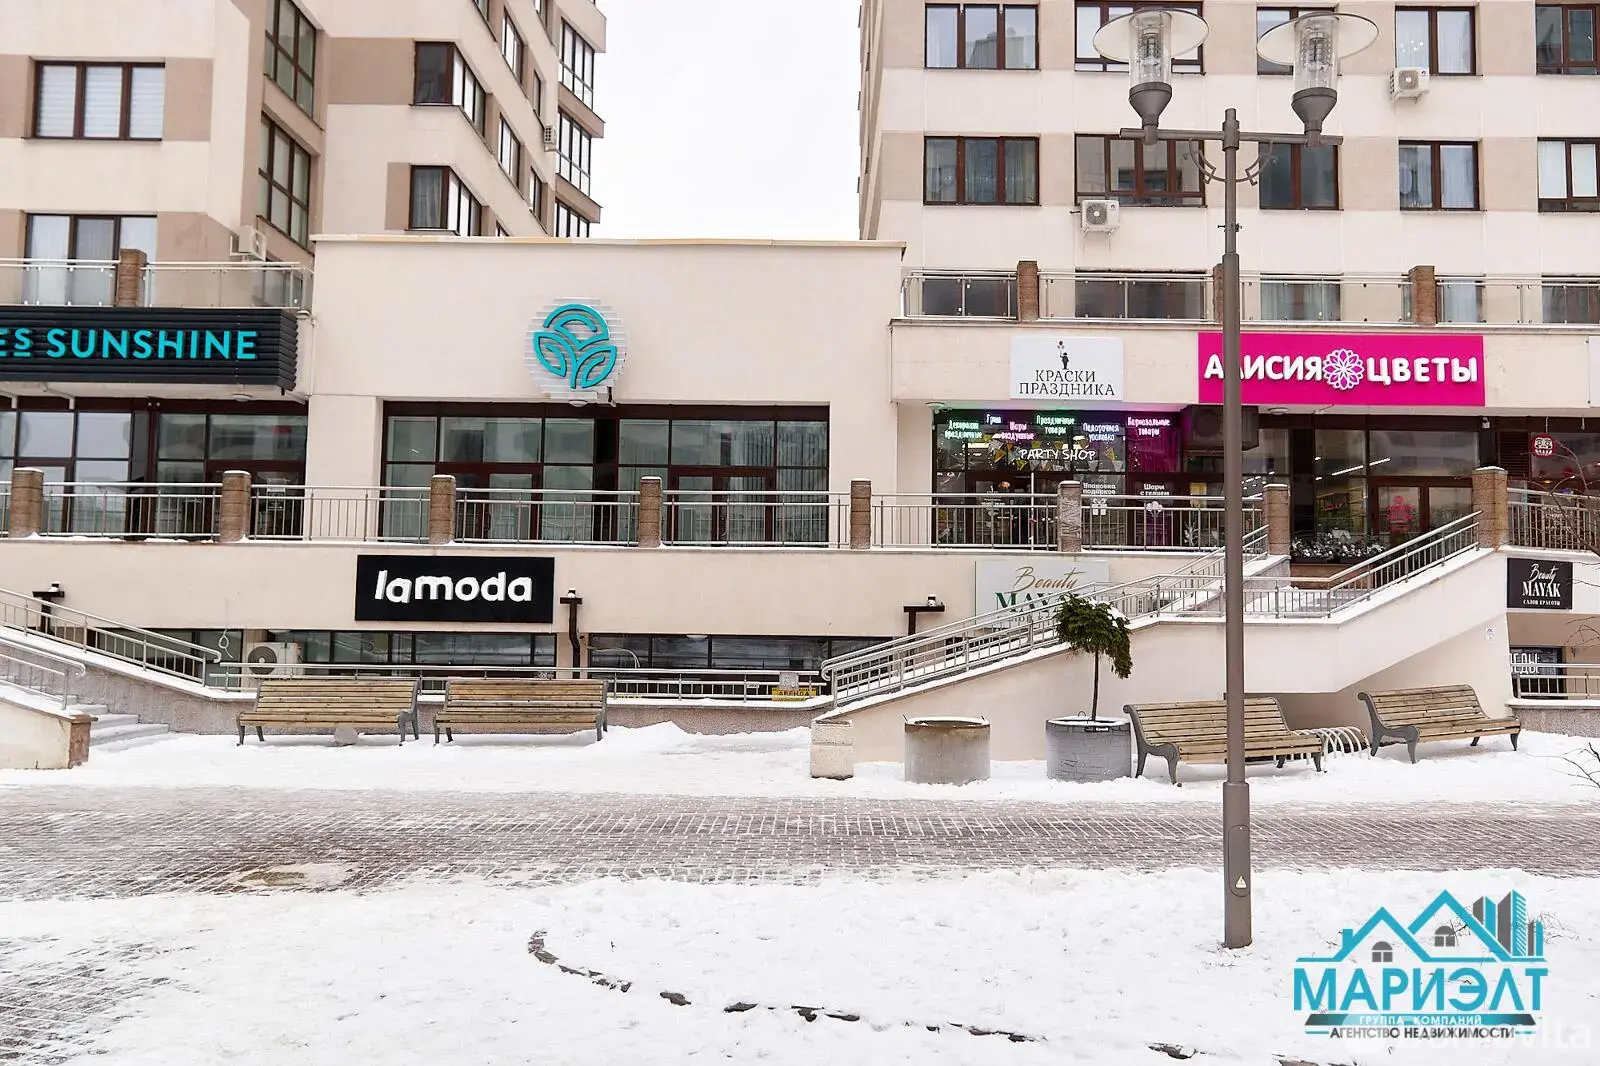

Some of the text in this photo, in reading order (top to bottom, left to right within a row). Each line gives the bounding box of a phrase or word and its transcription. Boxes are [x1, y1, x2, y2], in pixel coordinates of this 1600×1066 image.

[46, 328, 257, 359] SUNSHINE
[1035, 369, 1096, 383] КРАСКИ
[1203, 353, 1478, 386] АИСИЯ ЦВЕТЫ
[1019, 382, 1115, 397] ПРАЗДНИКА
[1018, 449, 1097, 461] PARTY SHOP
[1143, 483, 1166, 492] Шары
[1005, 566, 1086, 593] Beauty
[1527, 563, 1560, 584] Beauty
[374, 569, 534, 604] lamoda
[1522, 581, 1561, 598] MAYAK
